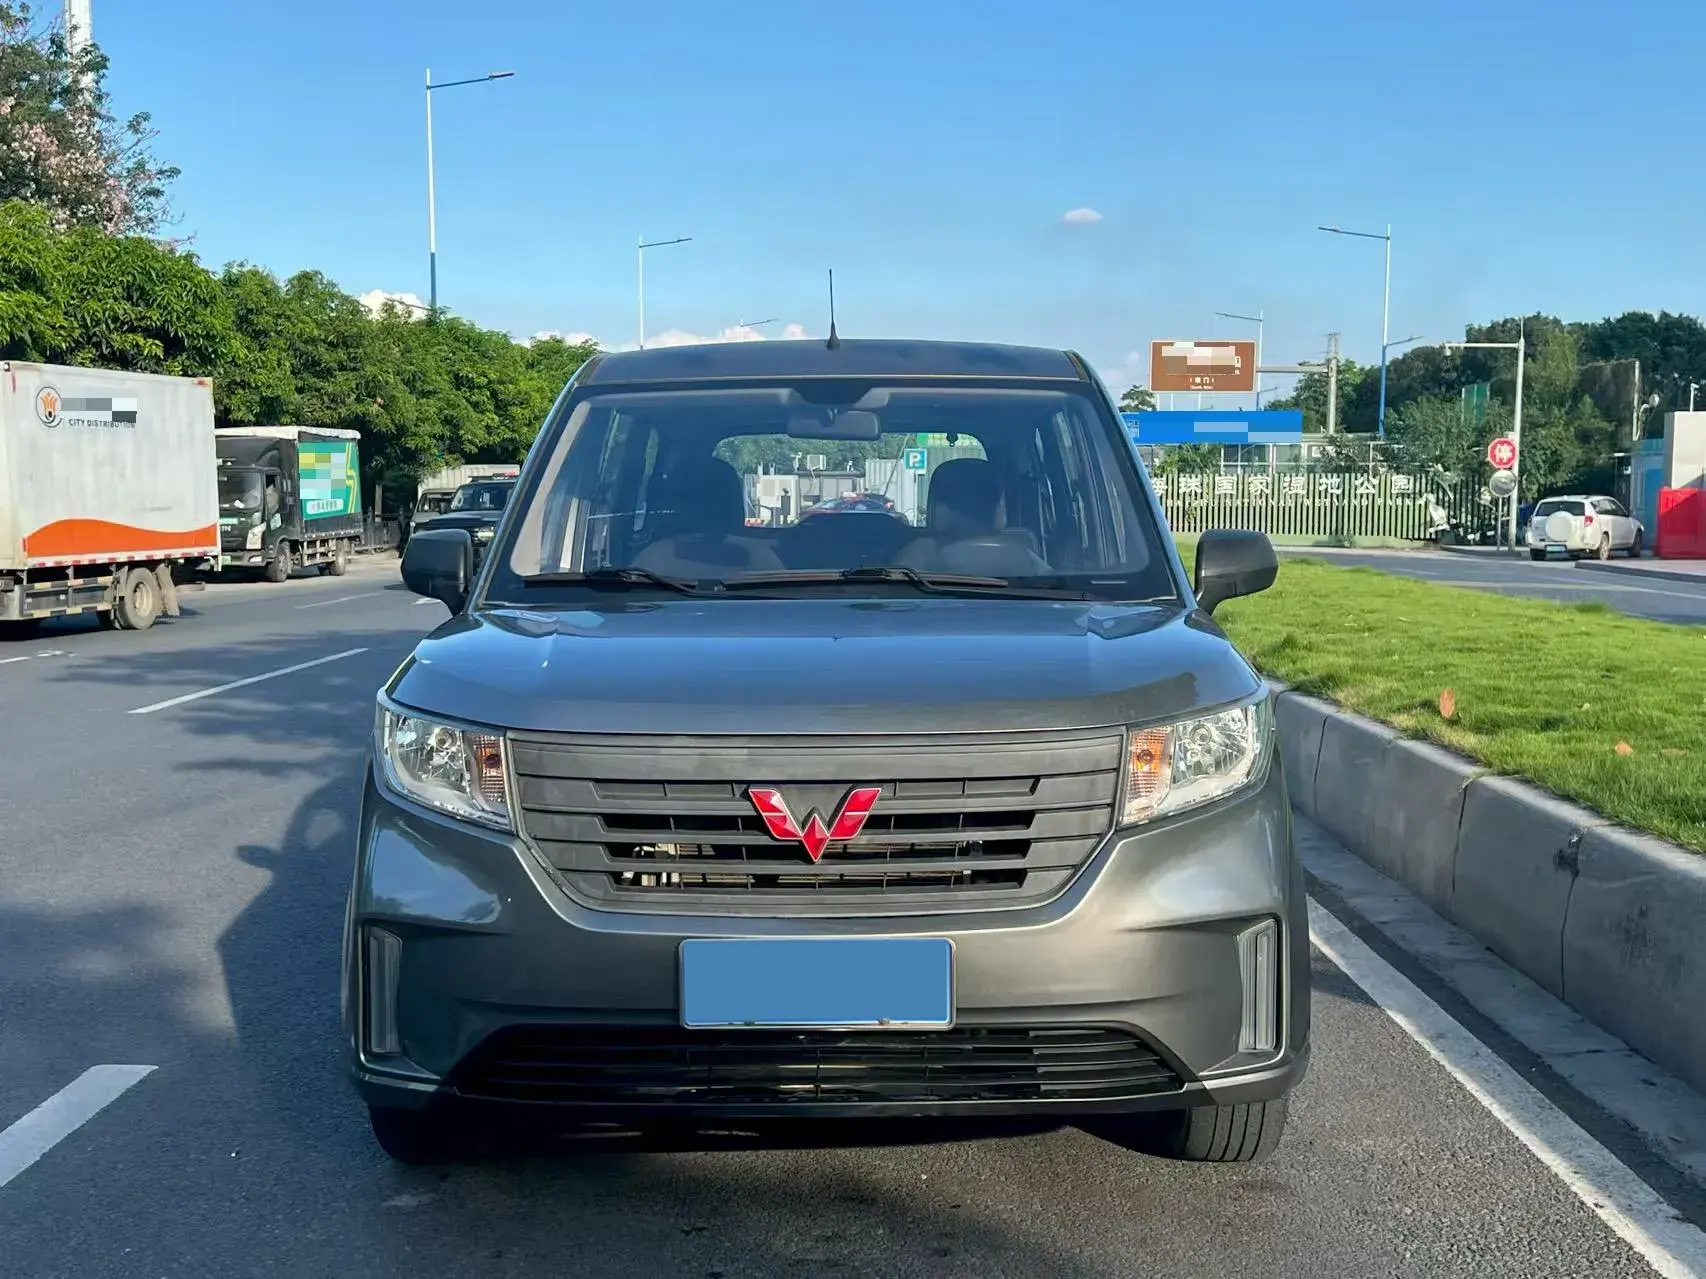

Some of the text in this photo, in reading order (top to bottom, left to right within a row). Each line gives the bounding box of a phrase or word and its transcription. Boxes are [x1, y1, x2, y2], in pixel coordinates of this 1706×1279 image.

[68, 418, 85, 427] CITY
[909, 452, 921, 468] P
[1225, 499, 1293, 507] NATIONAL
